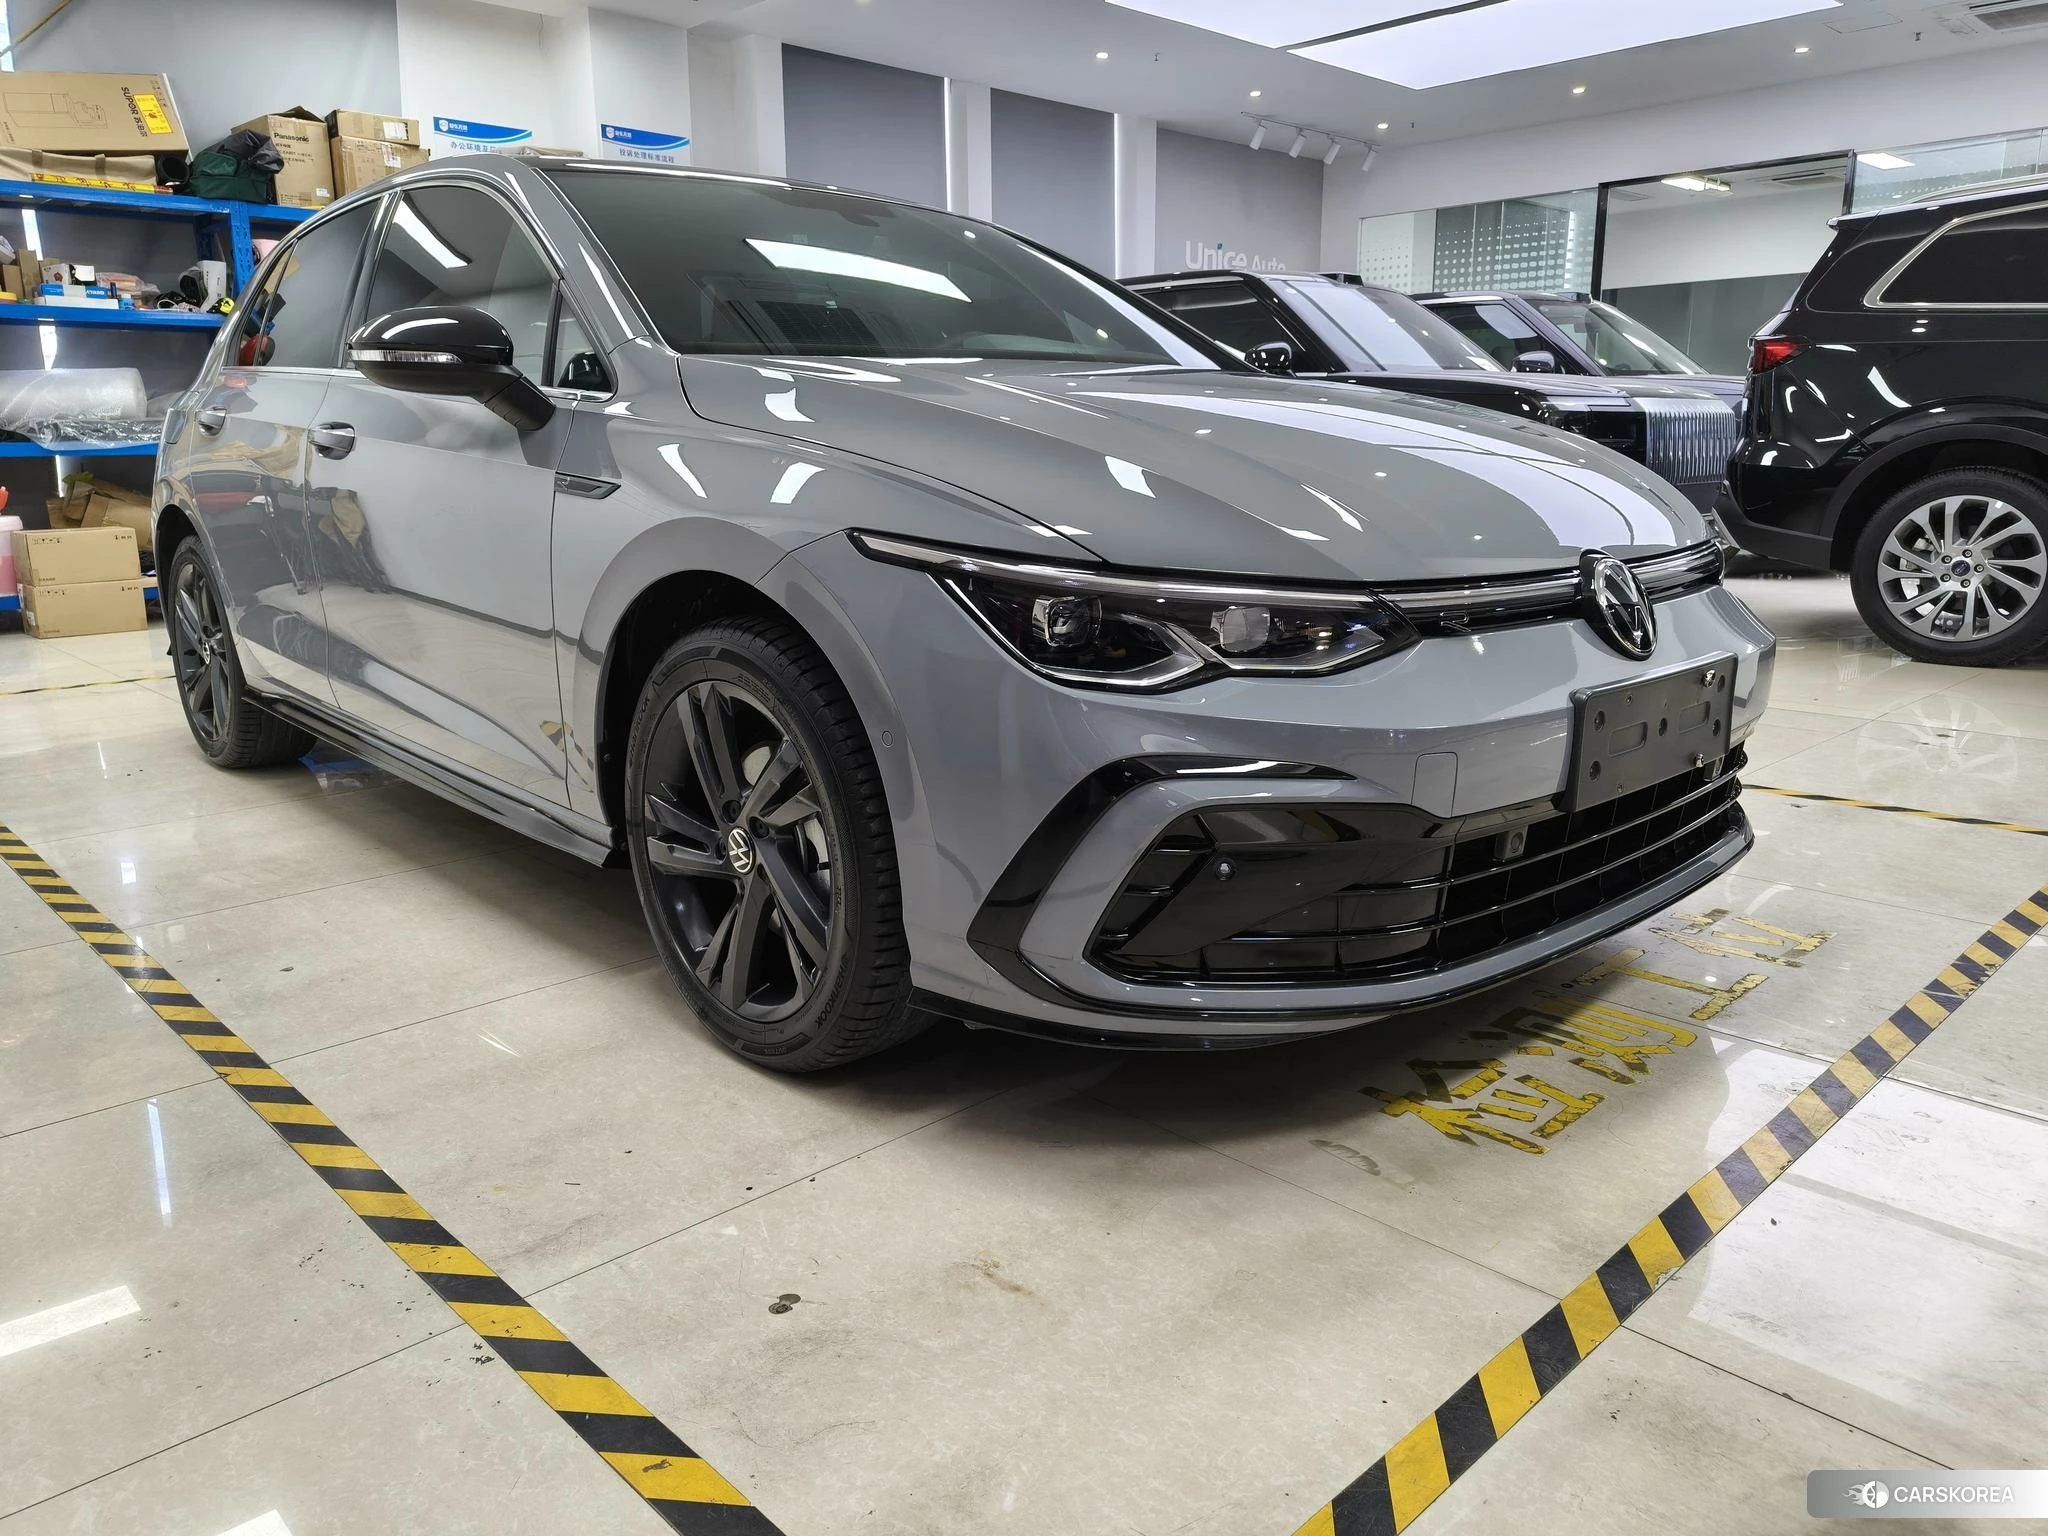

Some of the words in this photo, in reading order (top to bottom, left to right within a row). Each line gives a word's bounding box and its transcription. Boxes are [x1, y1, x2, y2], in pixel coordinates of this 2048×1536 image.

[121, 86, 139, 115] SUPOR
[273, 132, 310, 143] Panasonic
[1185, 240, 1247, 270] Unice
[1251, 254, 1286, 271] Auto
[1361, 907, 1838, 1156] 检测工位
